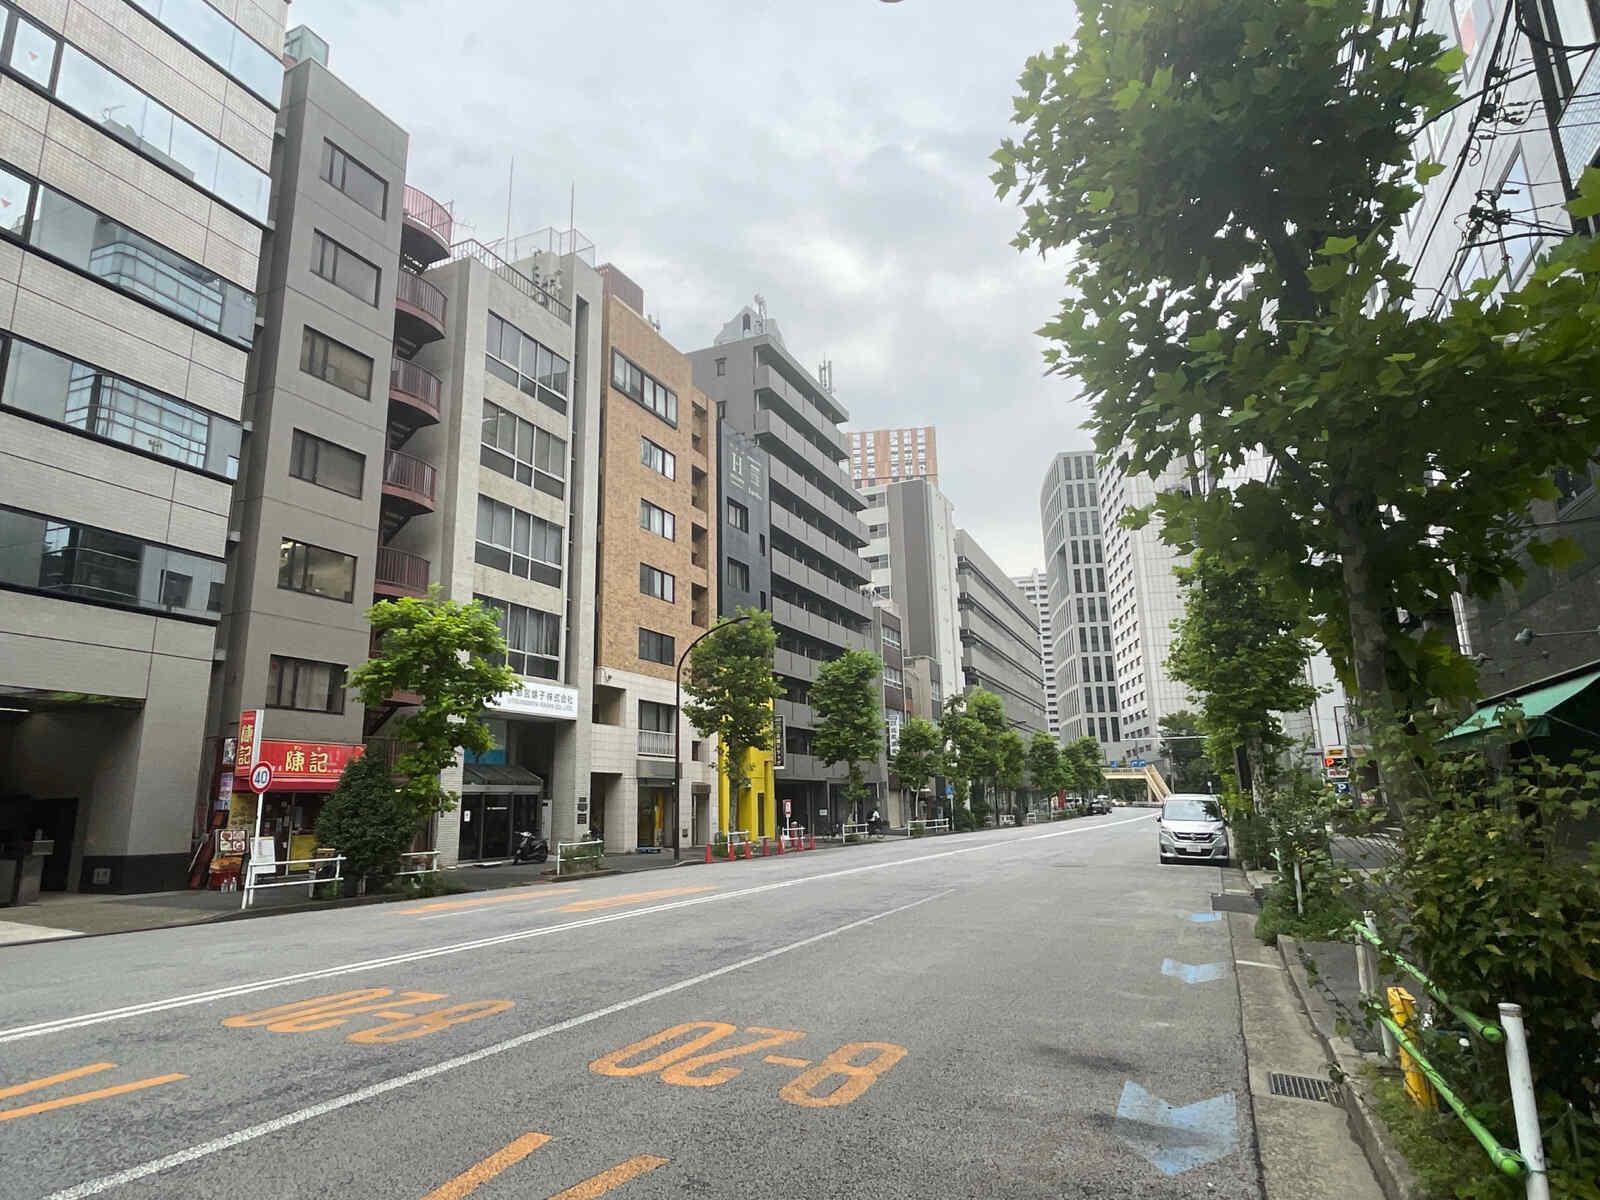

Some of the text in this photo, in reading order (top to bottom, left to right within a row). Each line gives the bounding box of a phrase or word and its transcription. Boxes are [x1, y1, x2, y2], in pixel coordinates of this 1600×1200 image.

[285, 751, 328, 773] 陳記
[254, 770, 268, 784] 40
[588, 1021, 908, 1107] 8-20
